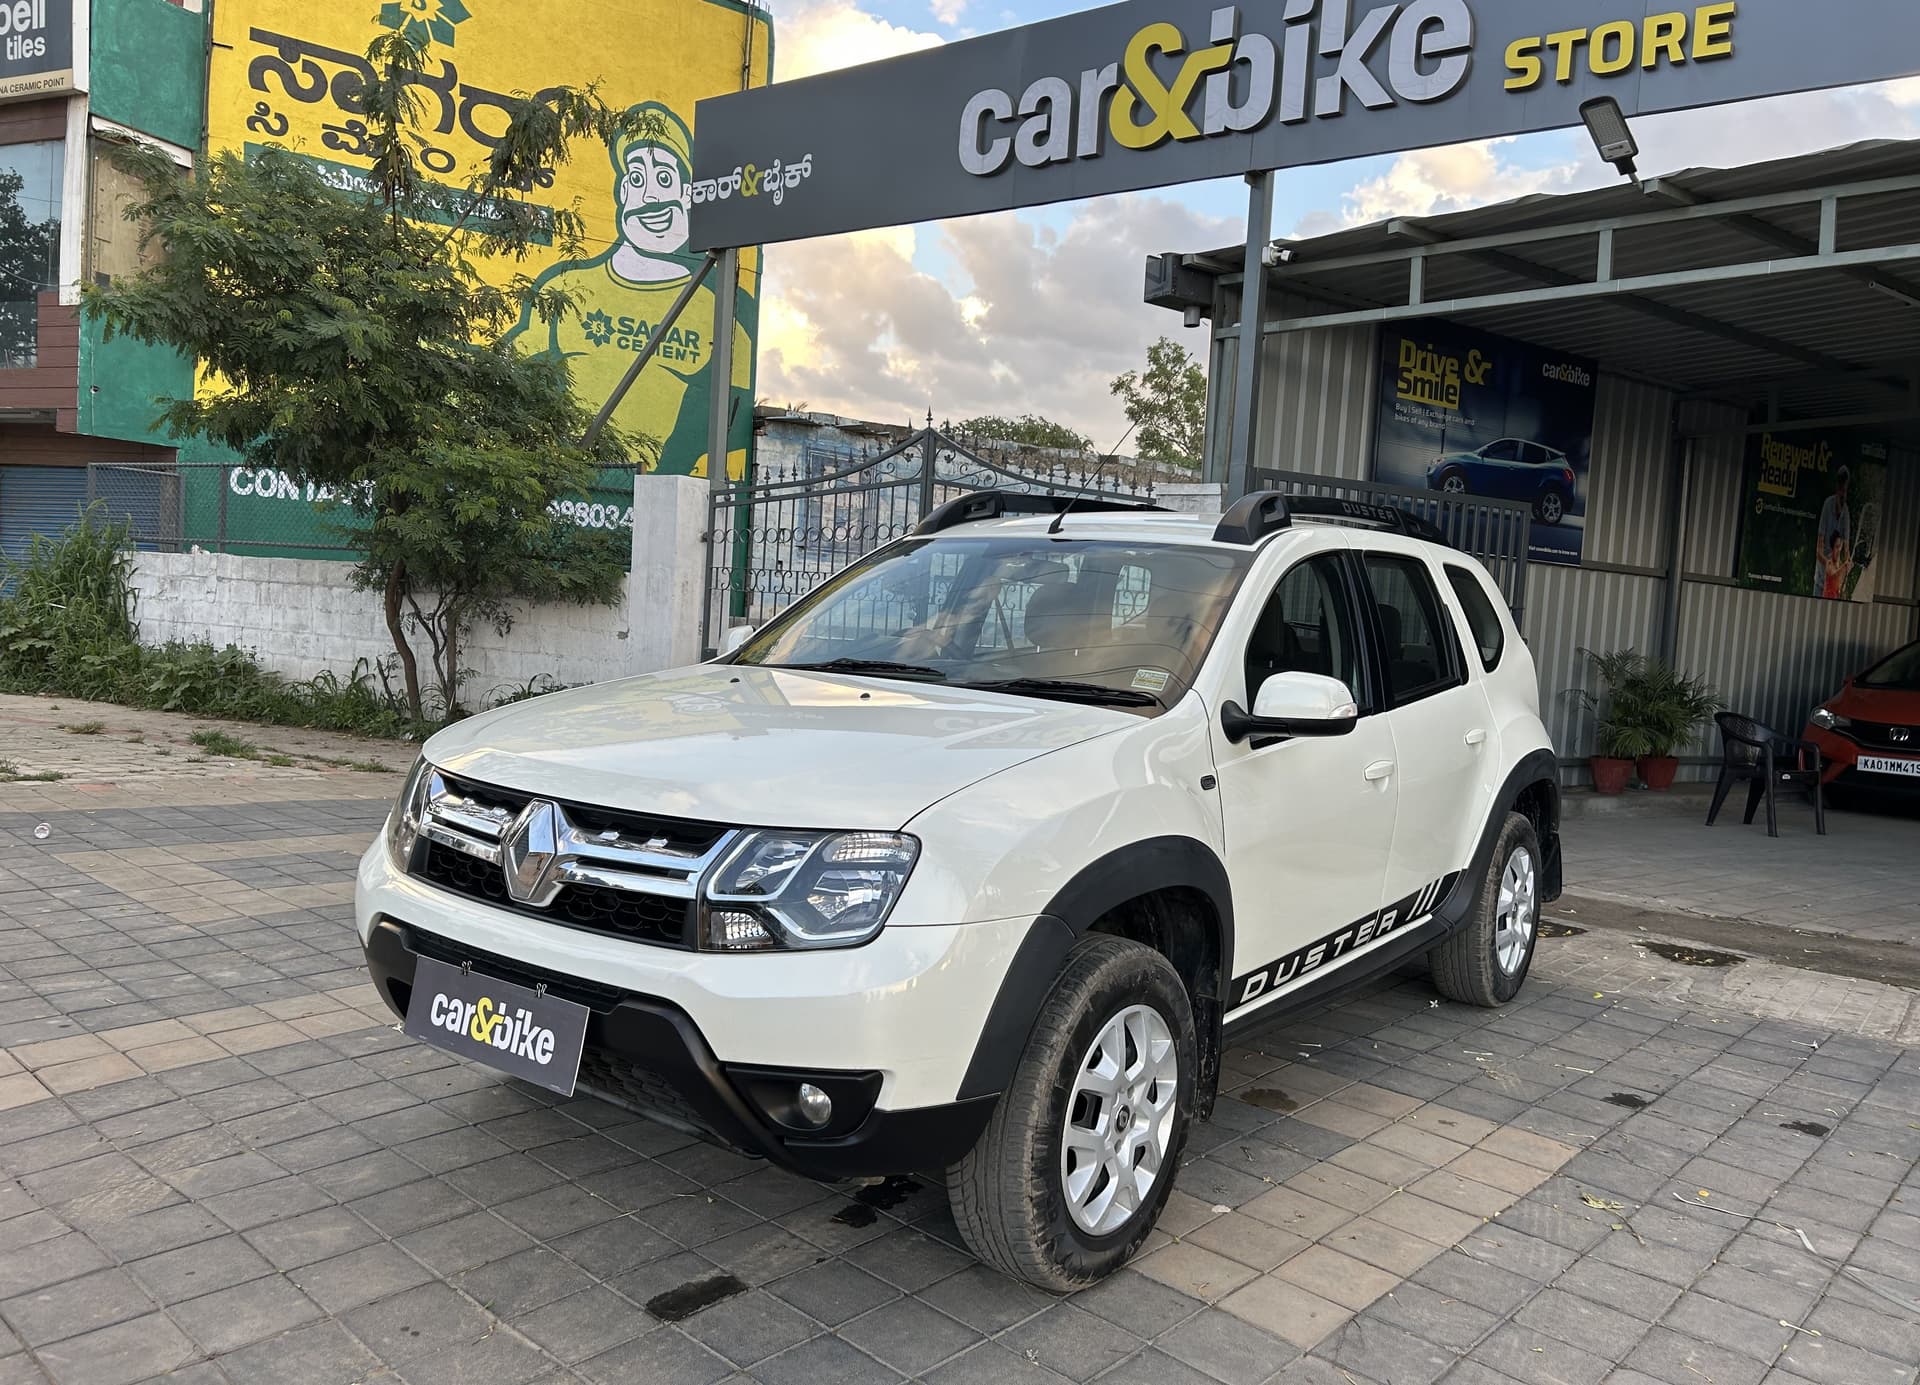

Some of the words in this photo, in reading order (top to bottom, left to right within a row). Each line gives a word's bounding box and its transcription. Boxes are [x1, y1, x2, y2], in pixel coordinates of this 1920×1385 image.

[7, 35, 46, 60] tiles
[1503, 2, 1737, 91] STORE
[10, 81, 41, 93] CERAMIC
[43, 77, 64, 89] POINT
[958, 0, 1474, 176] car&bike
[692, 153, 813, 206] ಕಾರ್&ಬೈಕ್
[616, 336, 701, 363] CEENT
[1399, 338, 1459, 380] Drive
[1464, 349, 1493, 385] &
[1397, 366, 1459, 405] Smile
[1542, 362, 1590, 387] car&bike
[1760, 432, 1817, 471] Renewed
[1342, 502, 1395, 522] DUSTER
[1240, 909, 1398, 1004] DUSTER
[430, 993, 555, 1065] car&bike
